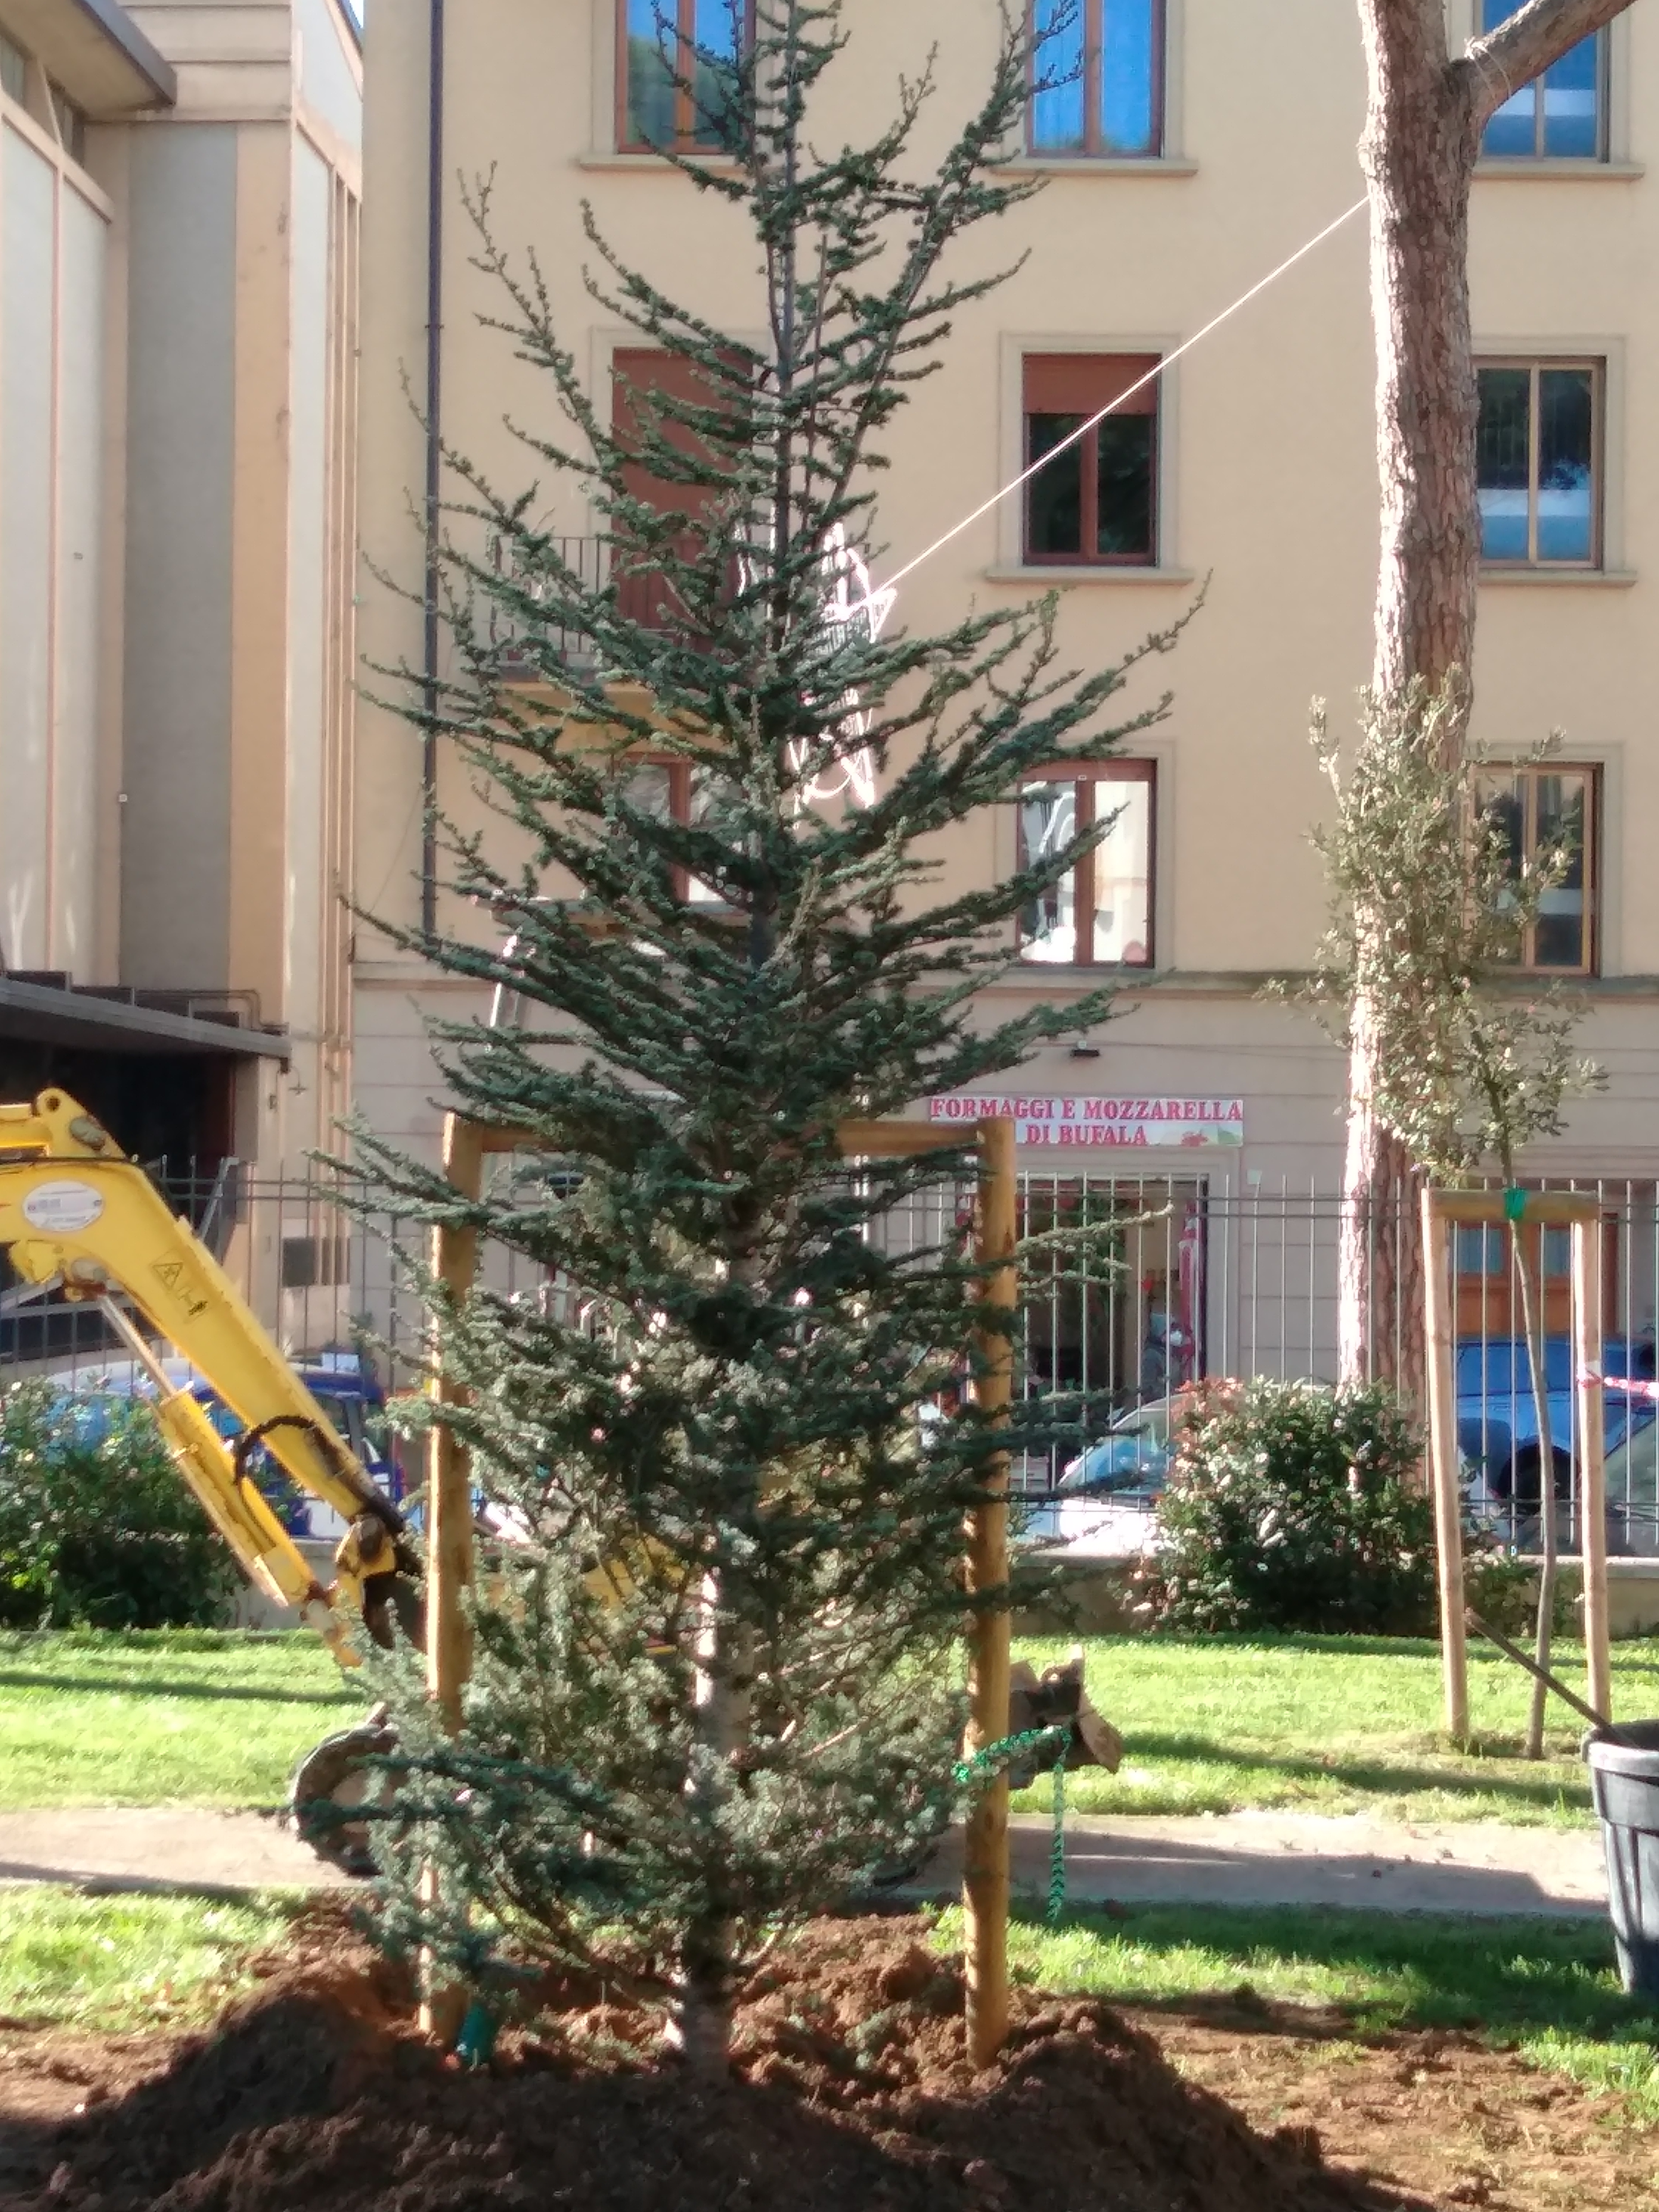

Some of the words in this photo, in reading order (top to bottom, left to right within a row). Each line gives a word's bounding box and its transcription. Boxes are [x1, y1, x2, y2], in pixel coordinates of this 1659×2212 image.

[931, 1098, 1054, 1119] FORMAGGI
[1062, 1100, 1075, 1119] E
[1083, 1099, 1243, 1121] MOZZARELLA
[1025, 1124, 1050, 1144] DI
[1058, 1124, 1148, 1145] BUFALA
